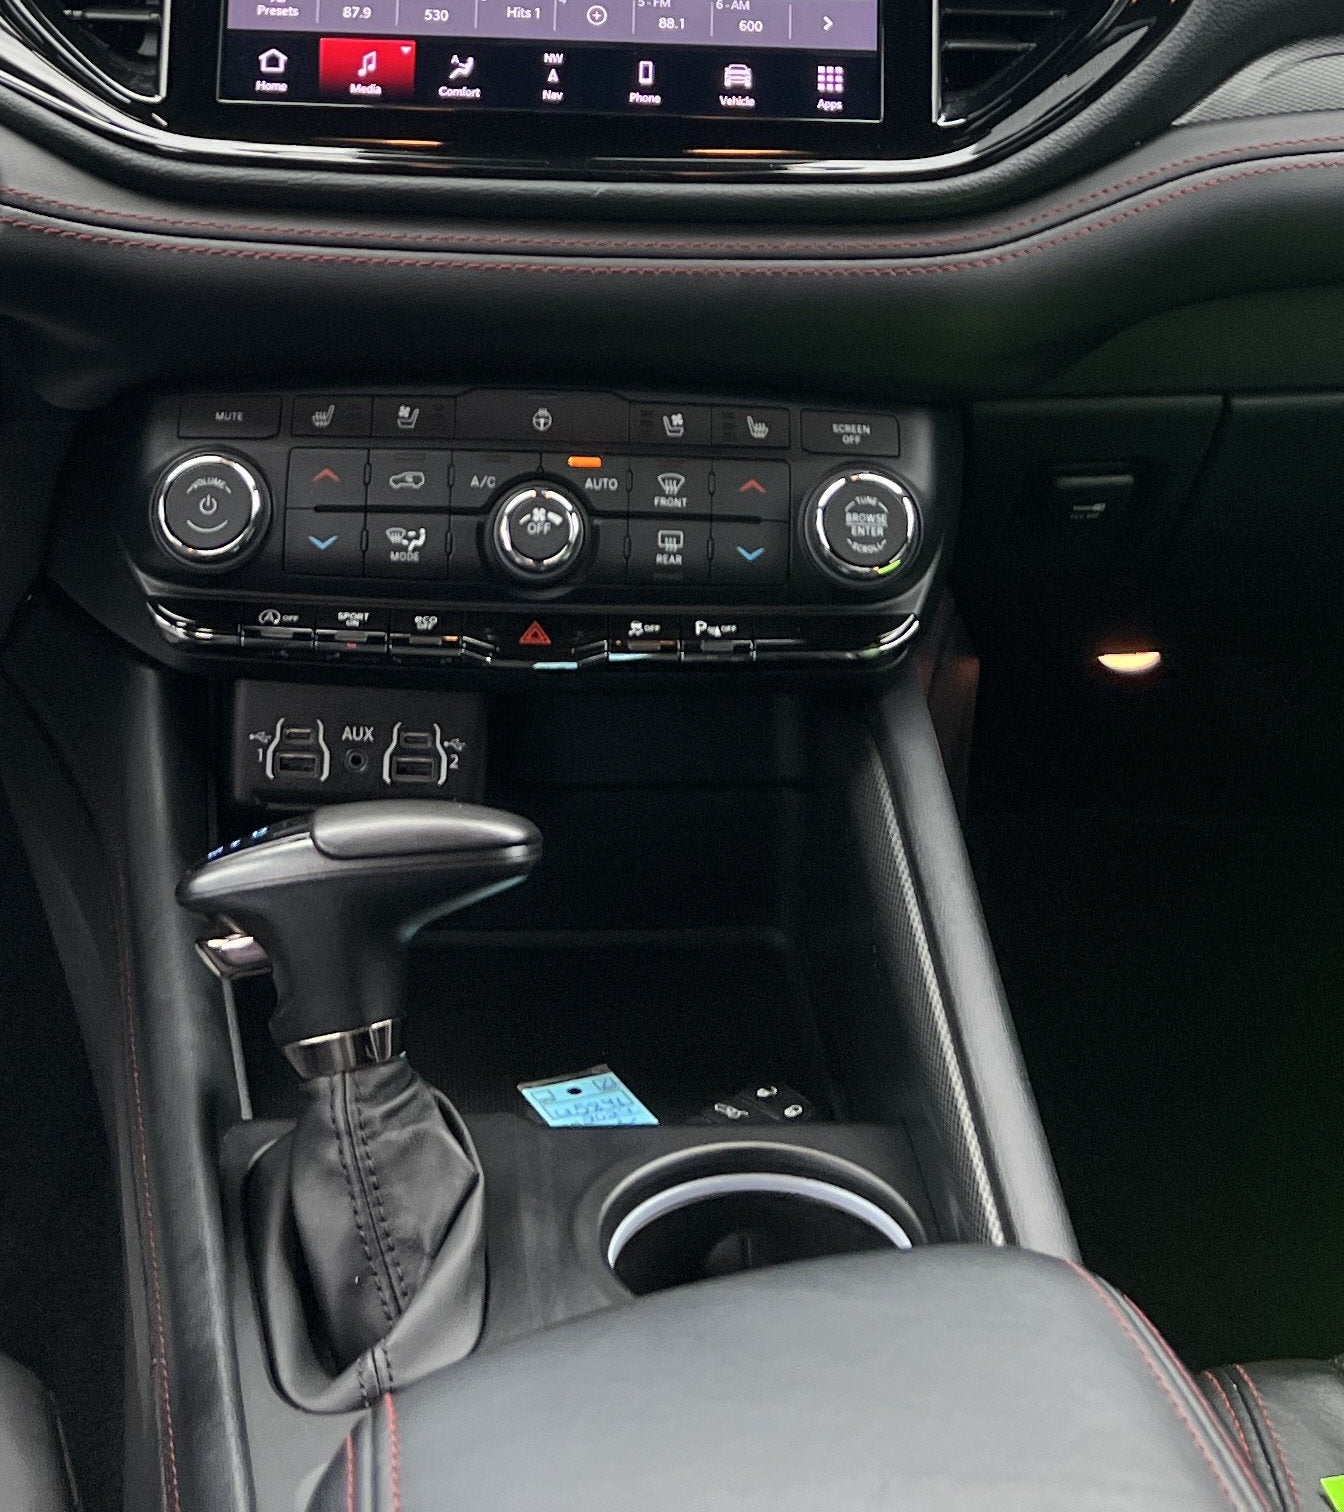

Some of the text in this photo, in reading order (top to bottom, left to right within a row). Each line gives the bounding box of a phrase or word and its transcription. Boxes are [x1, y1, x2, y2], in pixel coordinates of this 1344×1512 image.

[256, 4, 299, 17] Presets
[342, 6, 372, 20] 87.9
[424, 8, 449, 22] 530
[506, 6, 541, 20] Hits 1
[658, 17, 686, 30] 88.1
[739, 20, 763, 33] 600
[543, 52, 564, 65] NW
[255, 80, 288, 93] Home
[350, 82, 382, 96] Media
[438, 85, 481, 99] Comfort
[542, 89, 564, 102] Nav
[629, 91, 662, 105] Phone
[719, 94, 756, 108] Vehicle
[816, 98, 843, 111] Apps
[215, 410, 243, 422] MUTE
[832, 423, 871, 436] SCREEN
[842, 434, 861, 445] OFF
[192, 476, 228, 489] VOLUME
[470, 475, 496, 488] A/C
[584, 477, 619, 491] AUTO
[654, 496, 687, 508] FRONT
[846, 512, 887, 524] BROWSE
[527, 522, 552, 535] OFF
[851, 526, 884, 537] ENTER
[390, 550, 420, 562] MODE
[656, 554, 683, 566] REAR
[337, 611, 370, 622] SPORT
[341, 726, 374, 741] AUX
[257, 748, 263, 762] 1
[449, 754, 459, 769] 2
